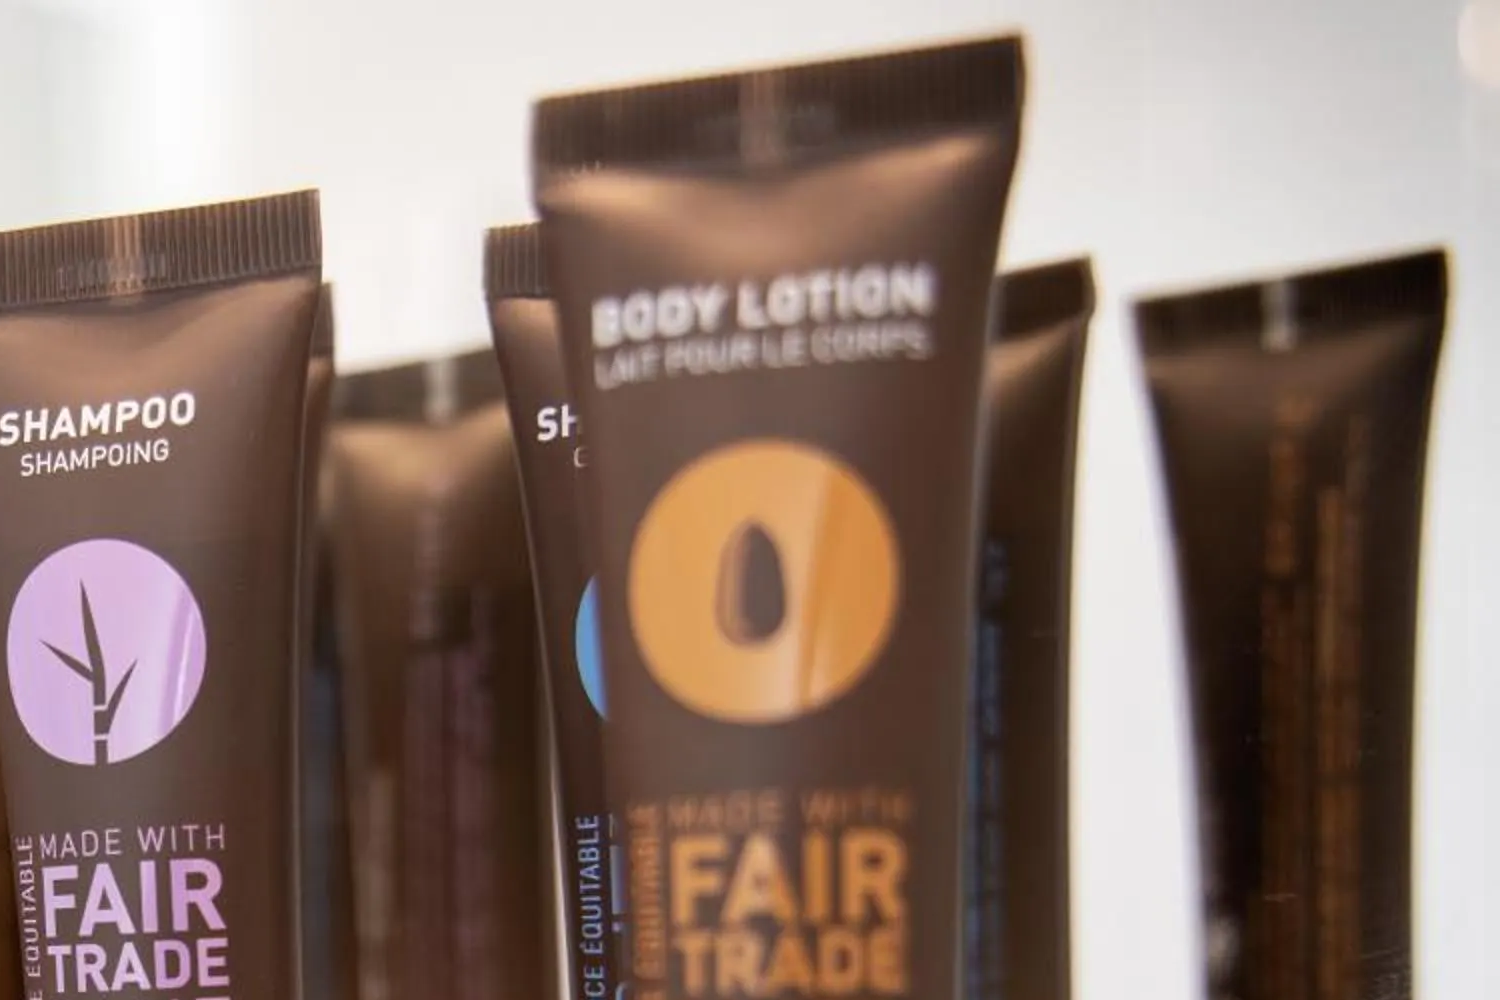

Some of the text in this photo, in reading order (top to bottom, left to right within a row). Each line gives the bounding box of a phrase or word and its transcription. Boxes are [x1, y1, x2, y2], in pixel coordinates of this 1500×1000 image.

[592, 264, 936, 348] BODY LOTION
[594, 344, 660, 389] LAIT
[664, 331, 757, 376] POUR
[761, 328, 805, 368] LE
[20, 438, 170, 477] SHAMPOING
[40, 824, 226, 859] MADE WITH
[42, 858, 226, 938] FAIR
[671, 828, 907, 926] FAIR
[47, 937, 231, 993] TRADE
[673, 927, 907, 996] TRADE
